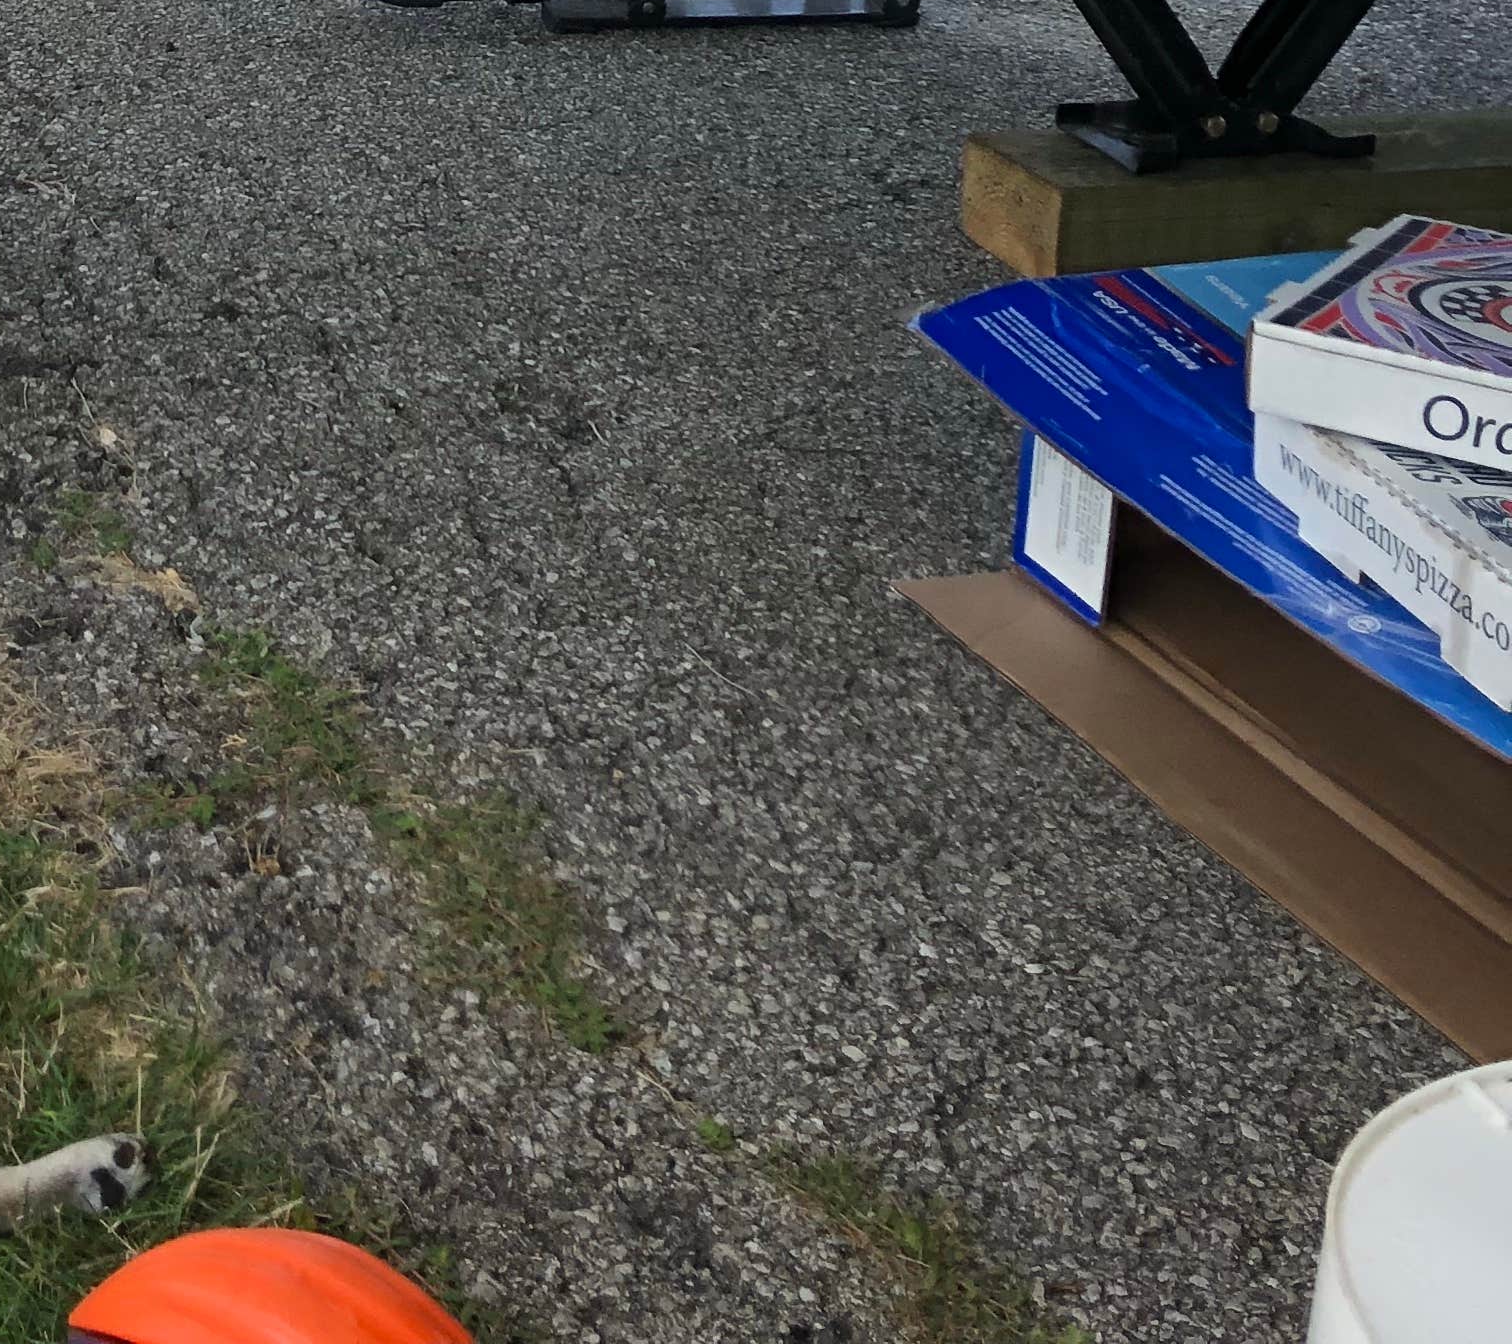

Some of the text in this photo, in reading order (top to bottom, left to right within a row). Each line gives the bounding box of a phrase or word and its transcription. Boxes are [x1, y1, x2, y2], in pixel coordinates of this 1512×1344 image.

[1092, 289, 1129, 315] USA
[1153, 335, 1202, 371] Made
[1278, 443, 1510, 652] www.tiffanyspizza.co
